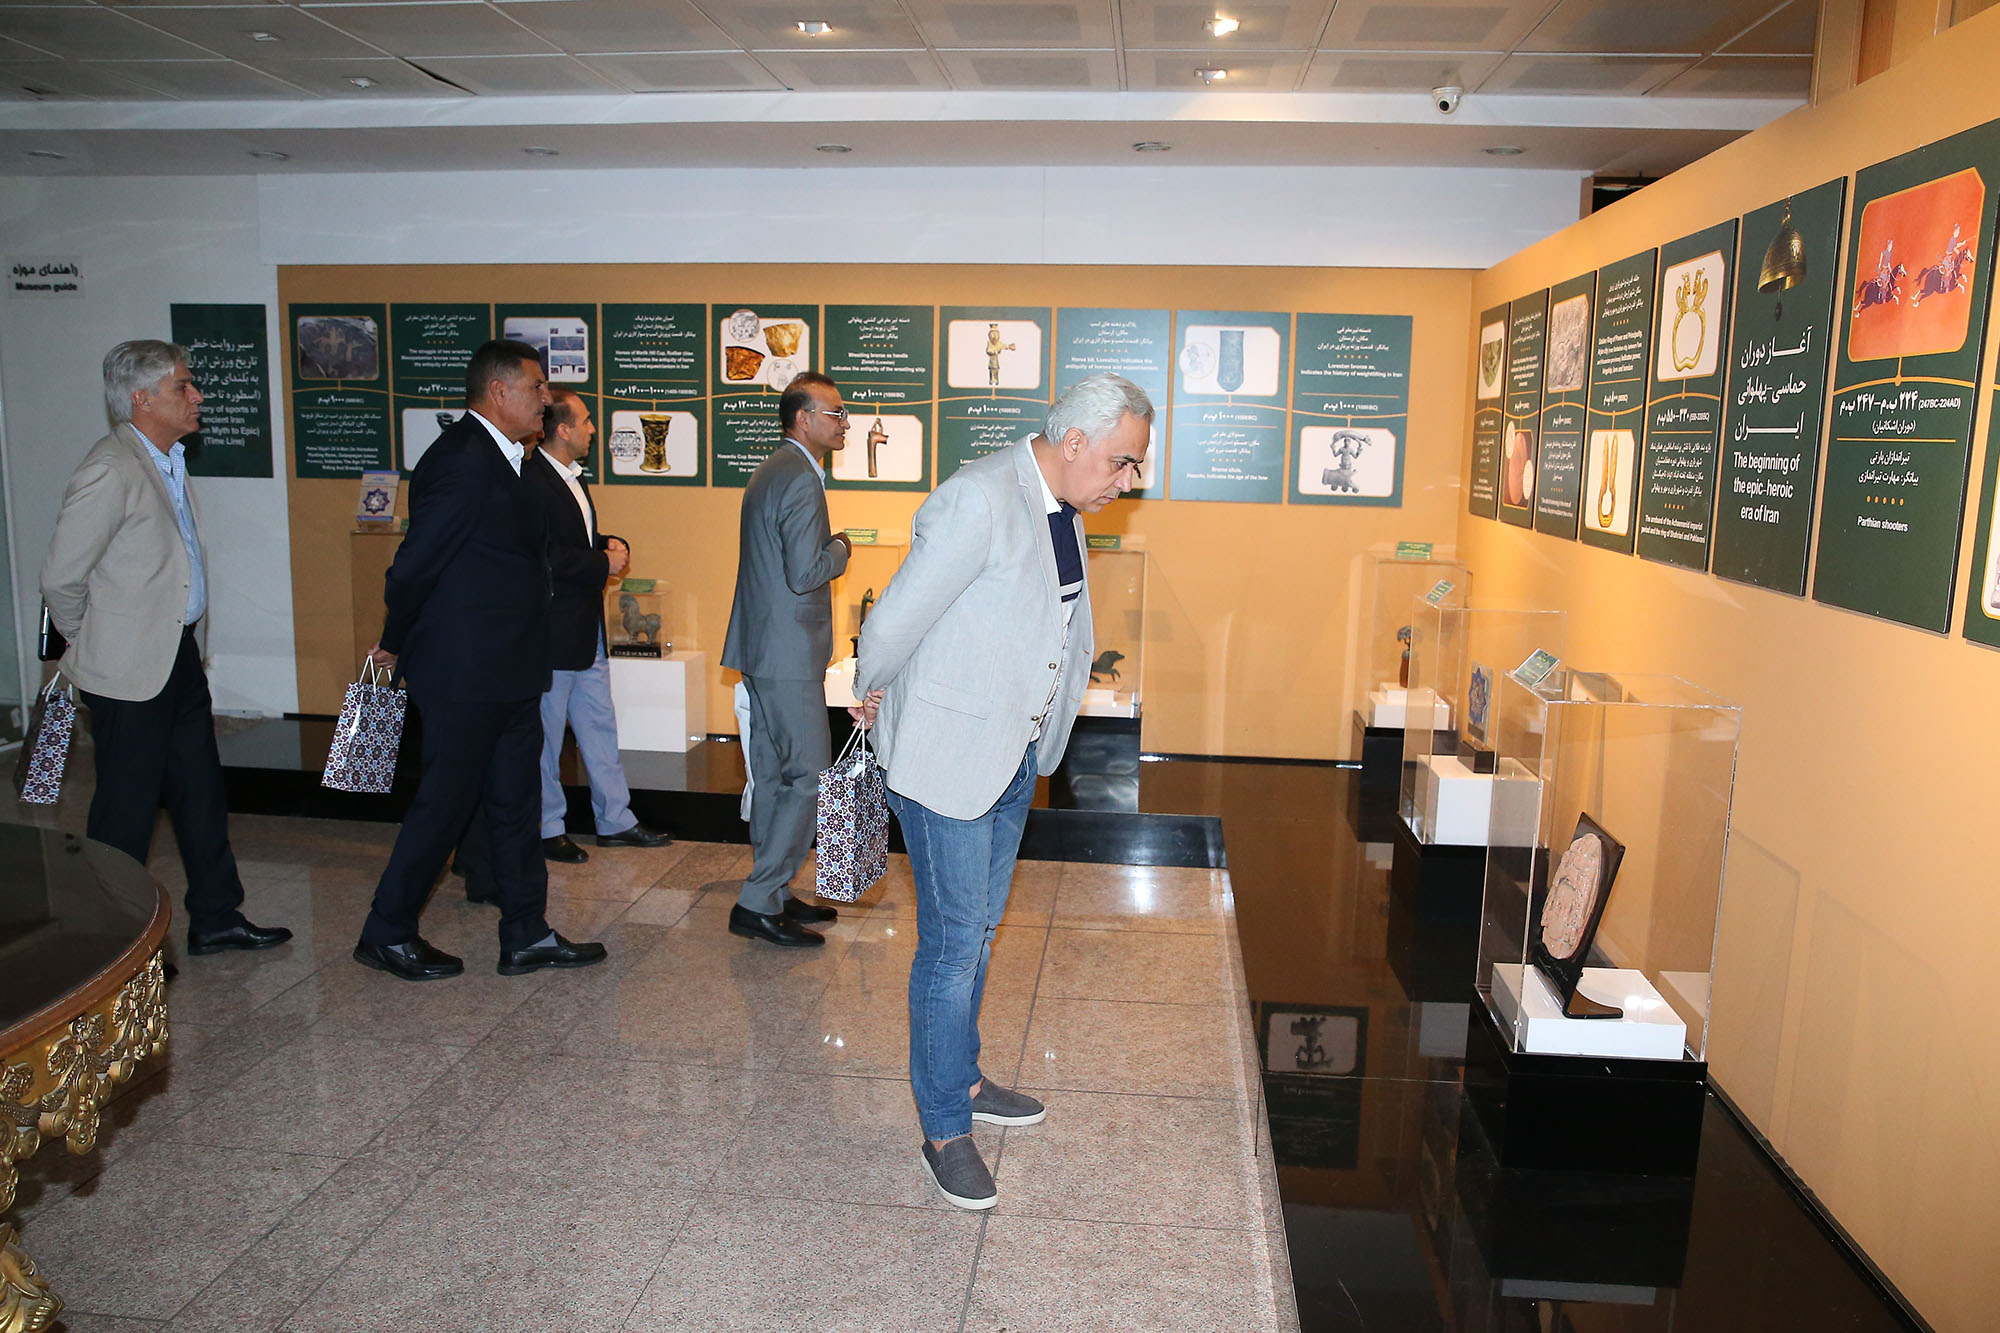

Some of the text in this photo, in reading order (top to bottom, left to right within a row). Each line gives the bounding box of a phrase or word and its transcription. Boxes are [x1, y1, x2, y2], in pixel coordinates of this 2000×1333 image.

[13, 263, 78, 277] راهنمای موزه
[15, 282, 78, 292] Museum guide
[187, 338, 255, 351] سیر روایت خطی
[1741, 325, 1813, 368] آغاز دوران
[209, 356, 234, 369] ورزش
[235, 356, 258, 369] تاریخ
[225, 405, 250, 414] sports
[983, 404, 998, 413] ۱۰۰۰
[1323, 402, 1338, 411] پ.م
[1339, 400, 1355, 410] ۱۰۰۰
[1918, 396, 1961, 410] (247BC-224AD)
[202, 416, 245, 424] ancient Iran
[1734, 411, 1805, 441] ایران
[212, 427, 230, 436] Myth
[1733, 451, 1801, 476] The beginning of
[1869, 451, 1886, 466] پارتی
[1858, 471, 1919, 486] بیانگر: مهارت تیراندازی
[1733, 476, 1794, 499] the epic-heroic
[1740, 504, 1780, 524] era of Iran
[1857, 515, 1908, 533] Parthian shooters
